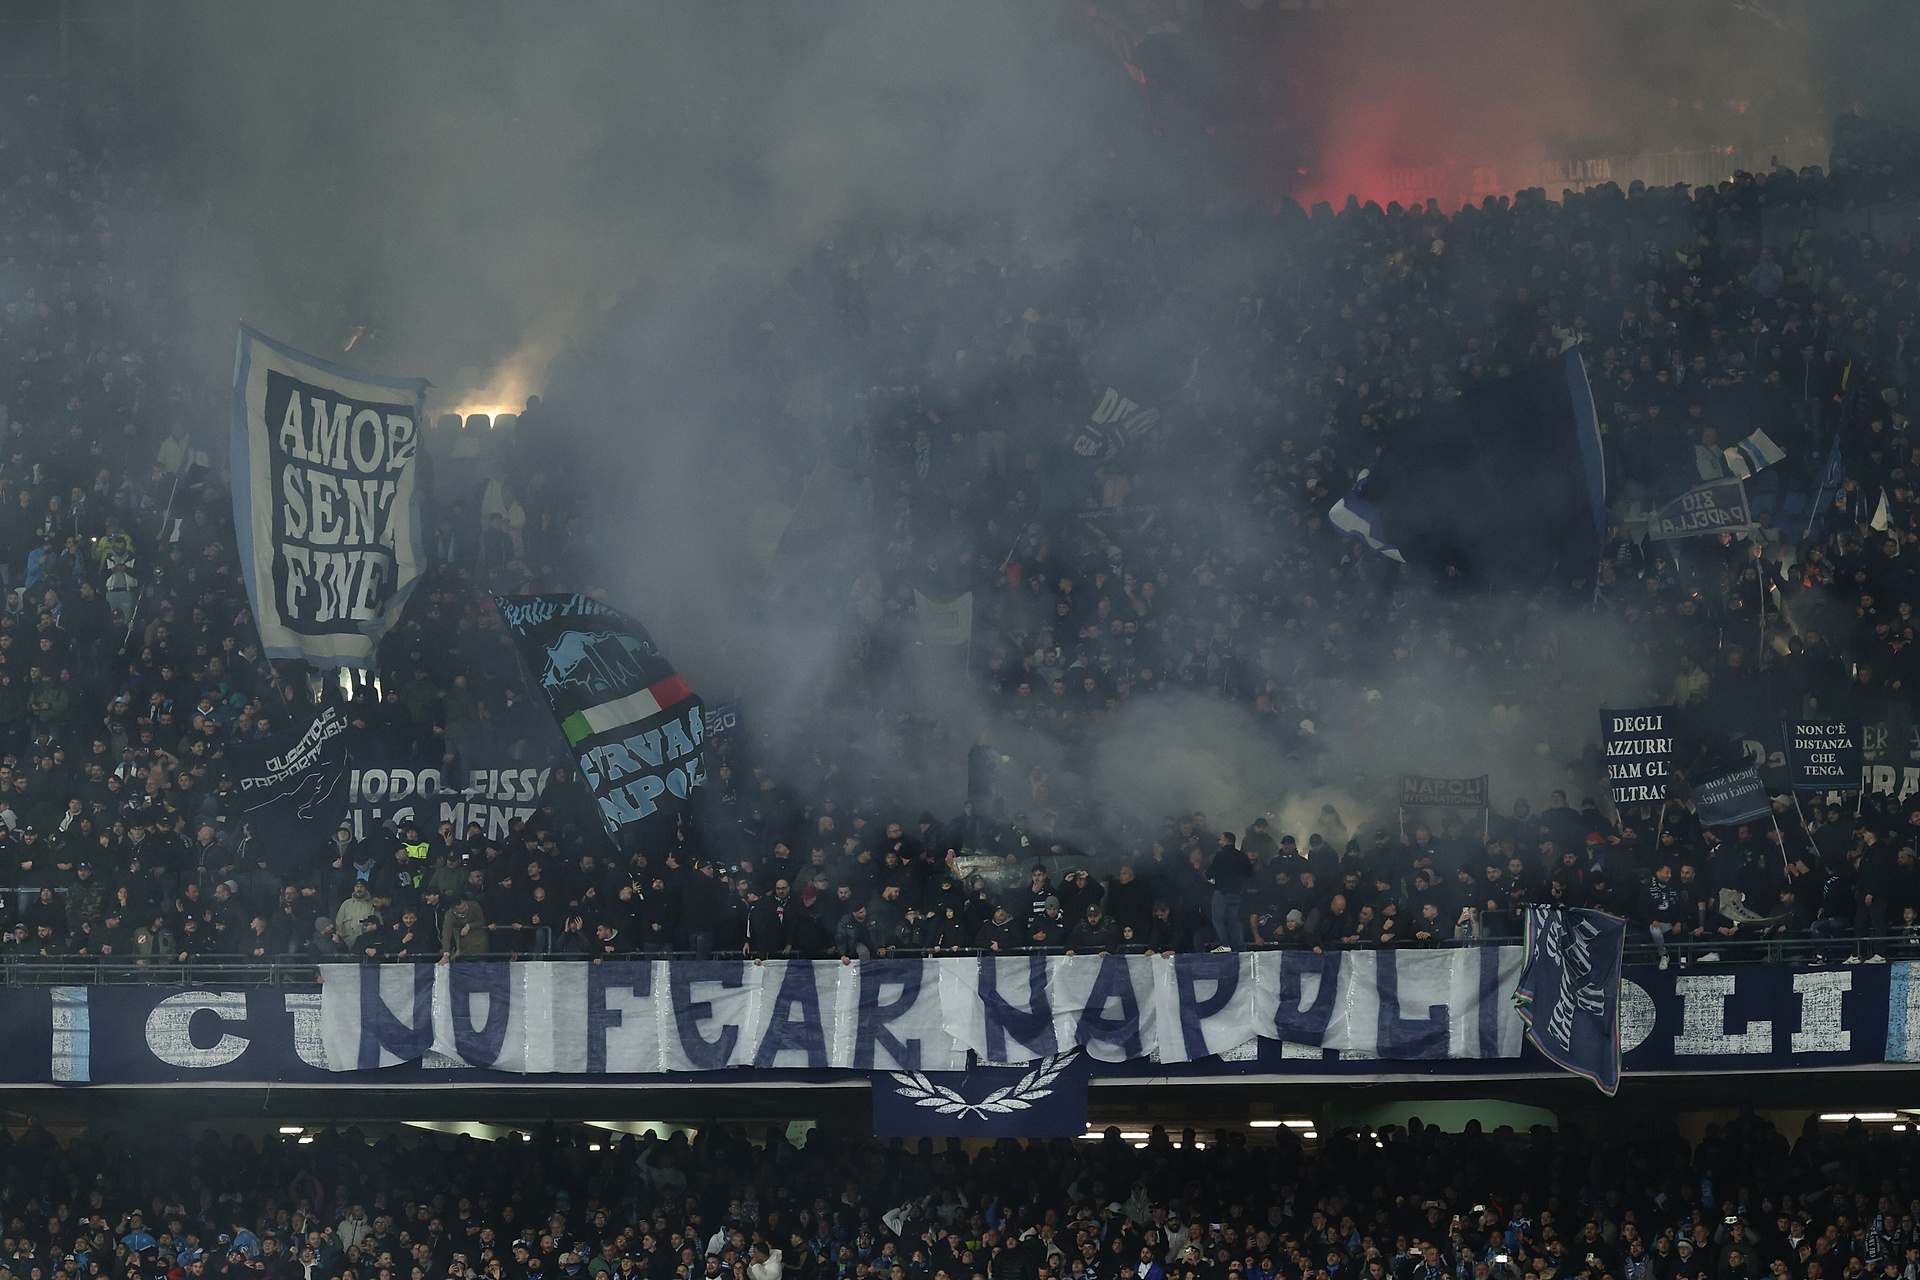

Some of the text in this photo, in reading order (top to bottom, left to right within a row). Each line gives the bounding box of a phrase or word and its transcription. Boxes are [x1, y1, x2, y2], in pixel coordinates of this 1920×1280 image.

[282, 543, 391, 622] FINE
[1613, 715, 1663, 733] DEGLI
[1796, 722, 1847, 735] NON C'È
[1606, 738, 1674, 756] AZZURRI
[1794, 738, 1853, 750] DISTANZA
[1811, 753, 1836, 763] CHE
[1607, 763, 1642, 780] SIAM
[1803, 765, 1845, 776] TENGA
[1403, 778, 1482, 794] NAPOLI
[1612, 785, 1667, 803] ULTRAS
[1403, 793, 1482, 804] INTERNATIONAL
[358, 946, 1500, 1073] NO FEAR NAPOLI
